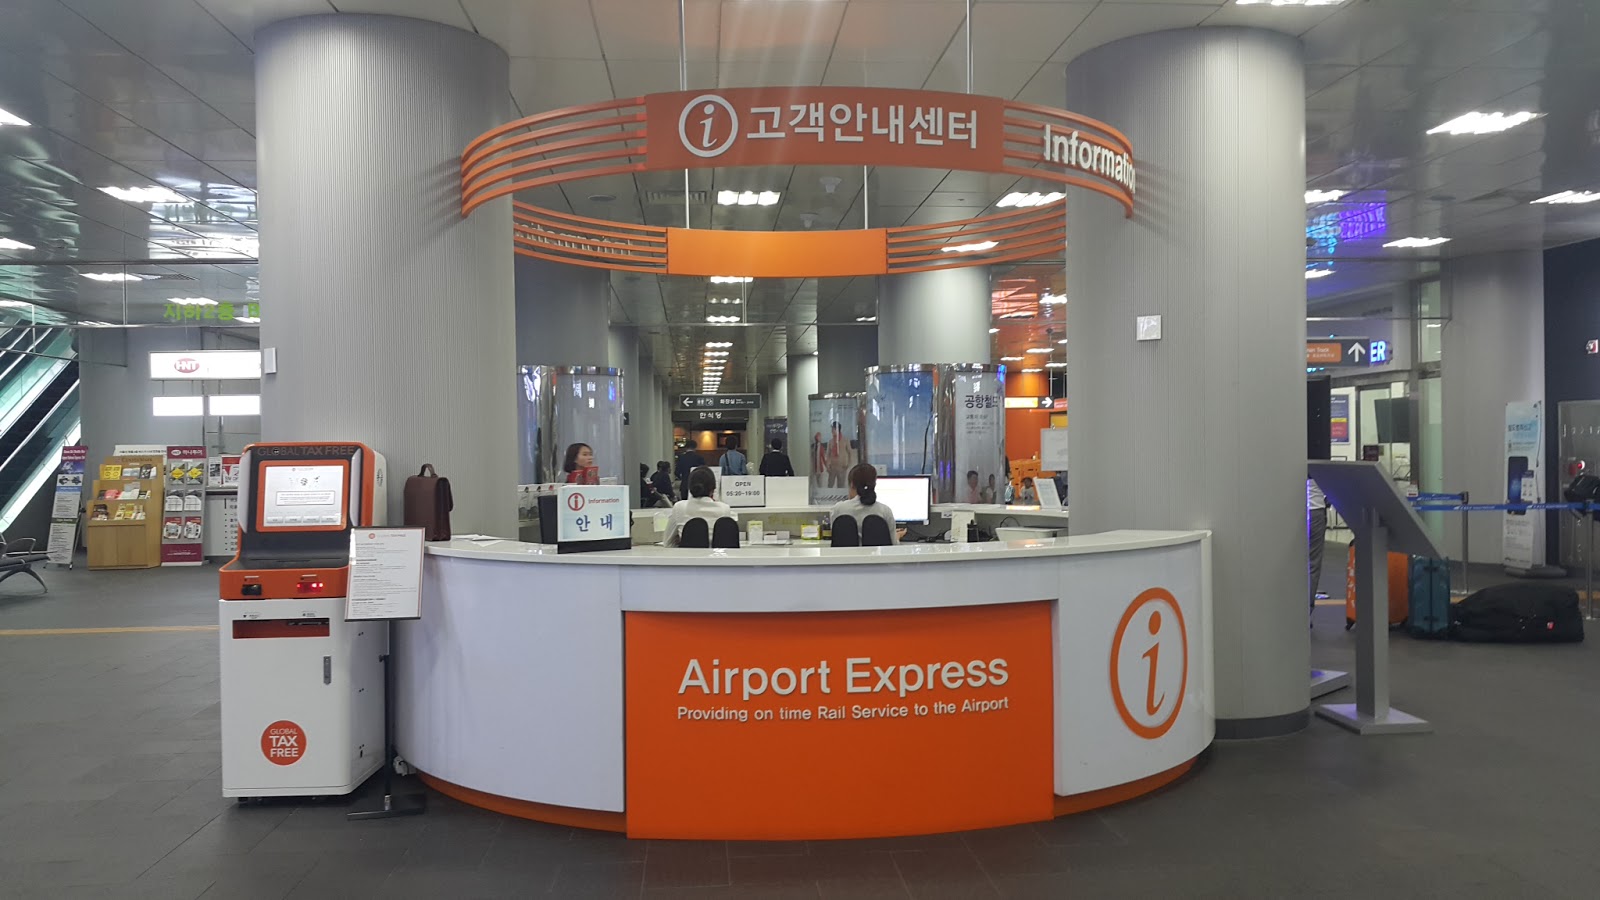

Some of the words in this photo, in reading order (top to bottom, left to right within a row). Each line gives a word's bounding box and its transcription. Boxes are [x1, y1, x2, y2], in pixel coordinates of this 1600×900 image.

[747, 101, 978, 149] 고객안내센터
[257, 447, 299, 456] GLOBAL
[301, 446, 323, 456] TAX
[325, 446, 355, 455] FREE
[678, 658, 831, 701] Airport
[846, 657, 1009, 698] Express
[677, 706, 748, 722] Providing
[754, 708, 773, 720] on
[779, 706, 812, 720] time
[817, 705, 846, 720] Rail
[851, 704, 908, 719] Service
[914, 703, 929, 716] to
[933, 701, 957, 715] the
[961, 697, 1009, 714] Airport
[269, 735, 298, 747] TAX
[270, 748, 298, 757] FREE
